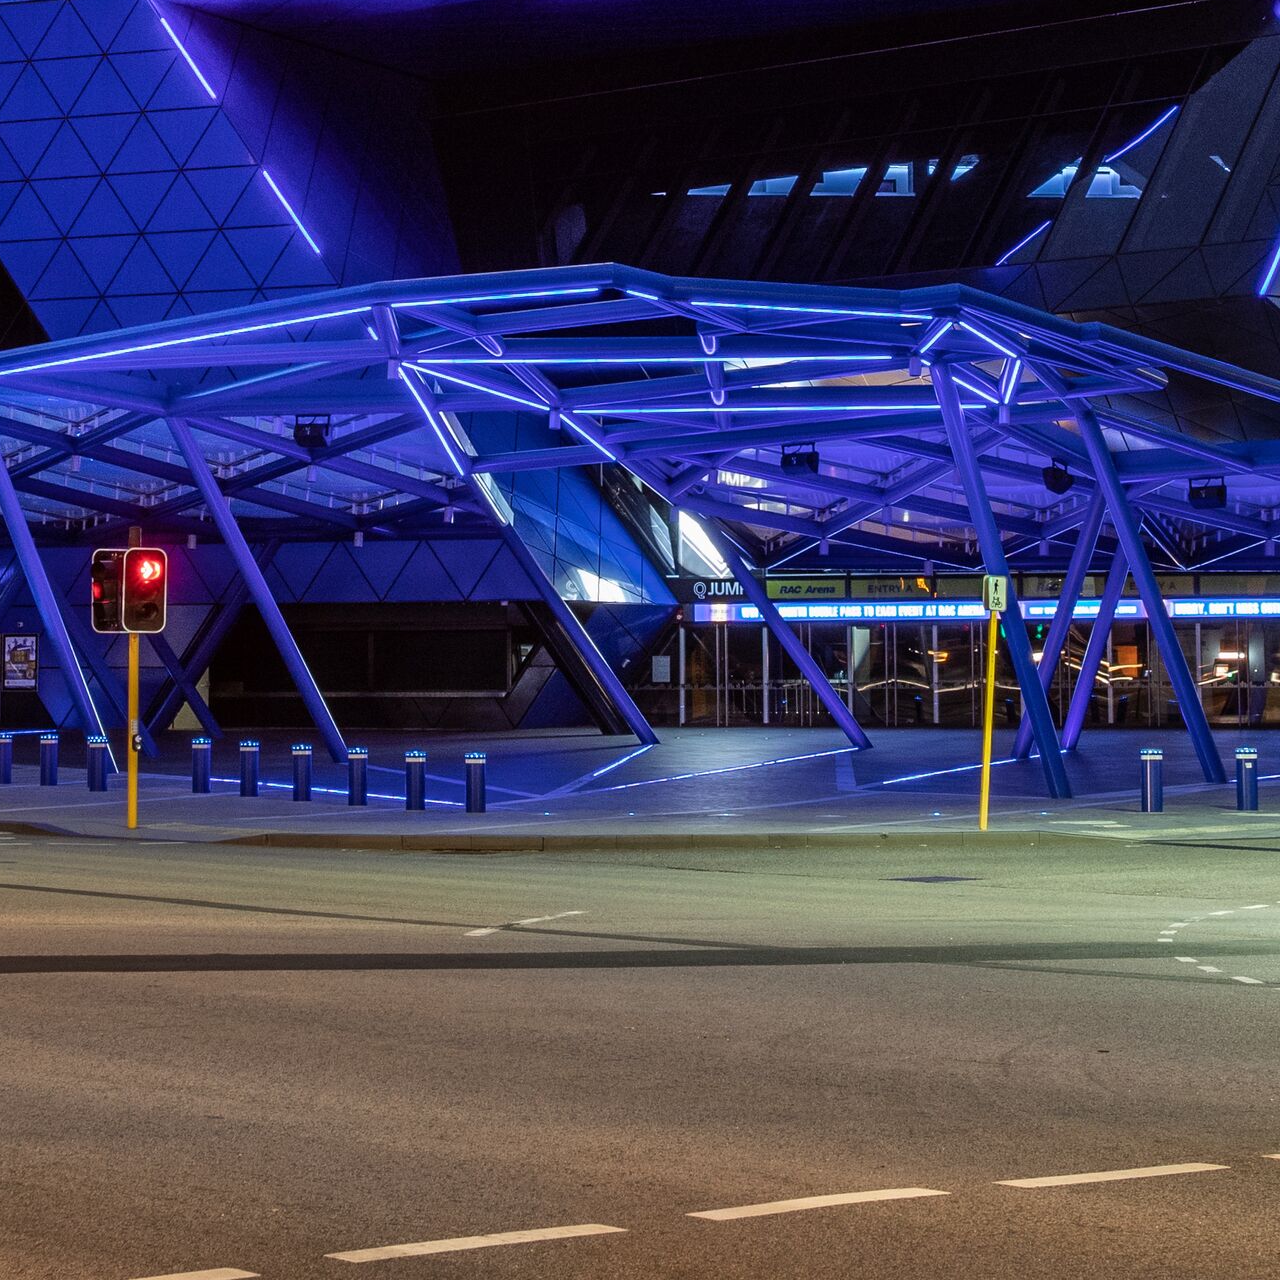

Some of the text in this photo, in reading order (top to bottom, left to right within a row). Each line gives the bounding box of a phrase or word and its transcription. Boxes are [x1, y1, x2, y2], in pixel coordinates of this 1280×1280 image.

[780, 585, 836, 594] RAC Arena
[867, 584, 901, 594] ENTRY
